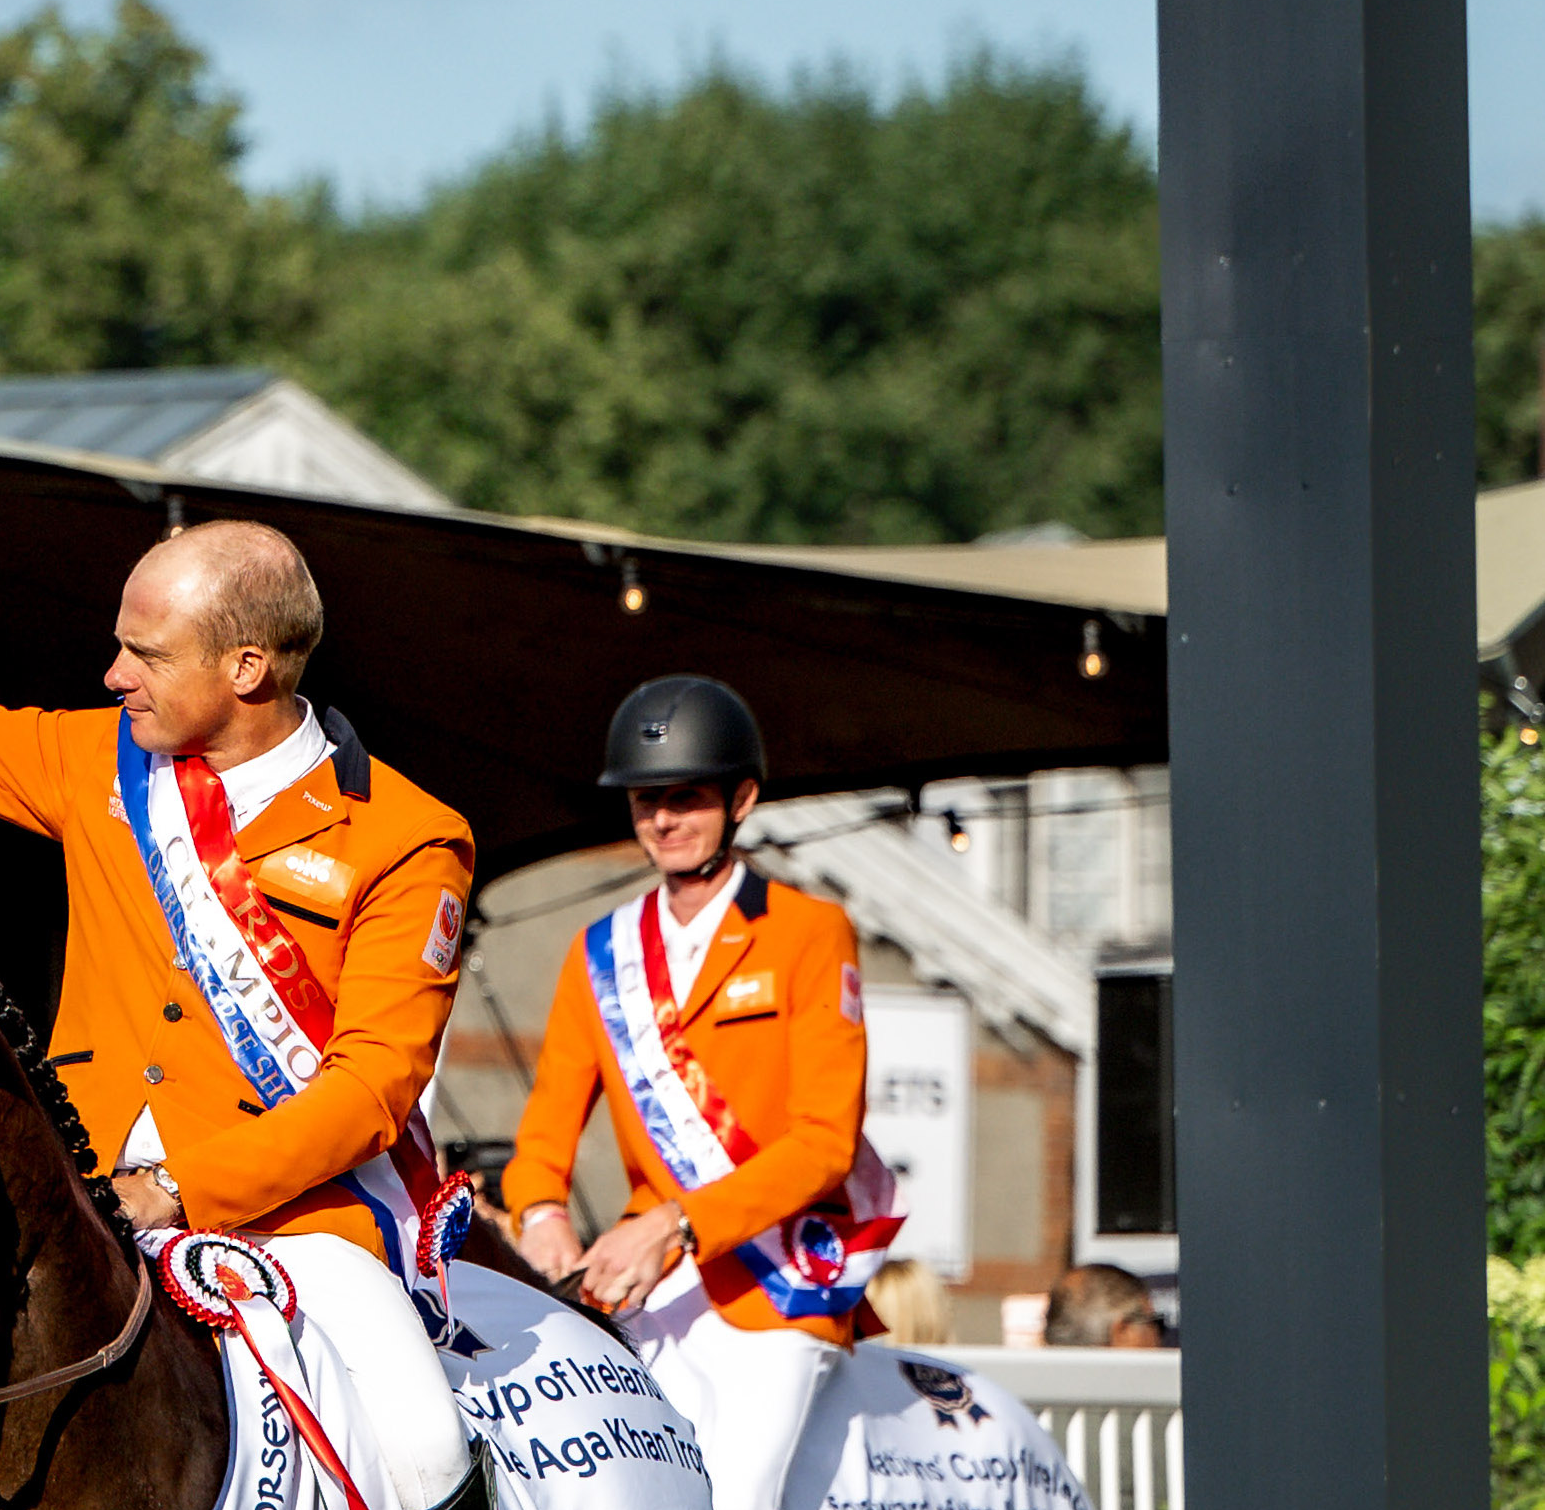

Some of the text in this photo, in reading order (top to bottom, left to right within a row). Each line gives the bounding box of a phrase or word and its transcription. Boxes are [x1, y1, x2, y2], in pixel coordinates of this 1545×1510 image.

[230, 891, 320, 1011] RDS
[534, 1360, 578, 1401] of
[529, 1430, 615, 1479] Aga
[602, 1417, 673, 1464] Khan
[950, 1453, 1009, 1488] Cup
